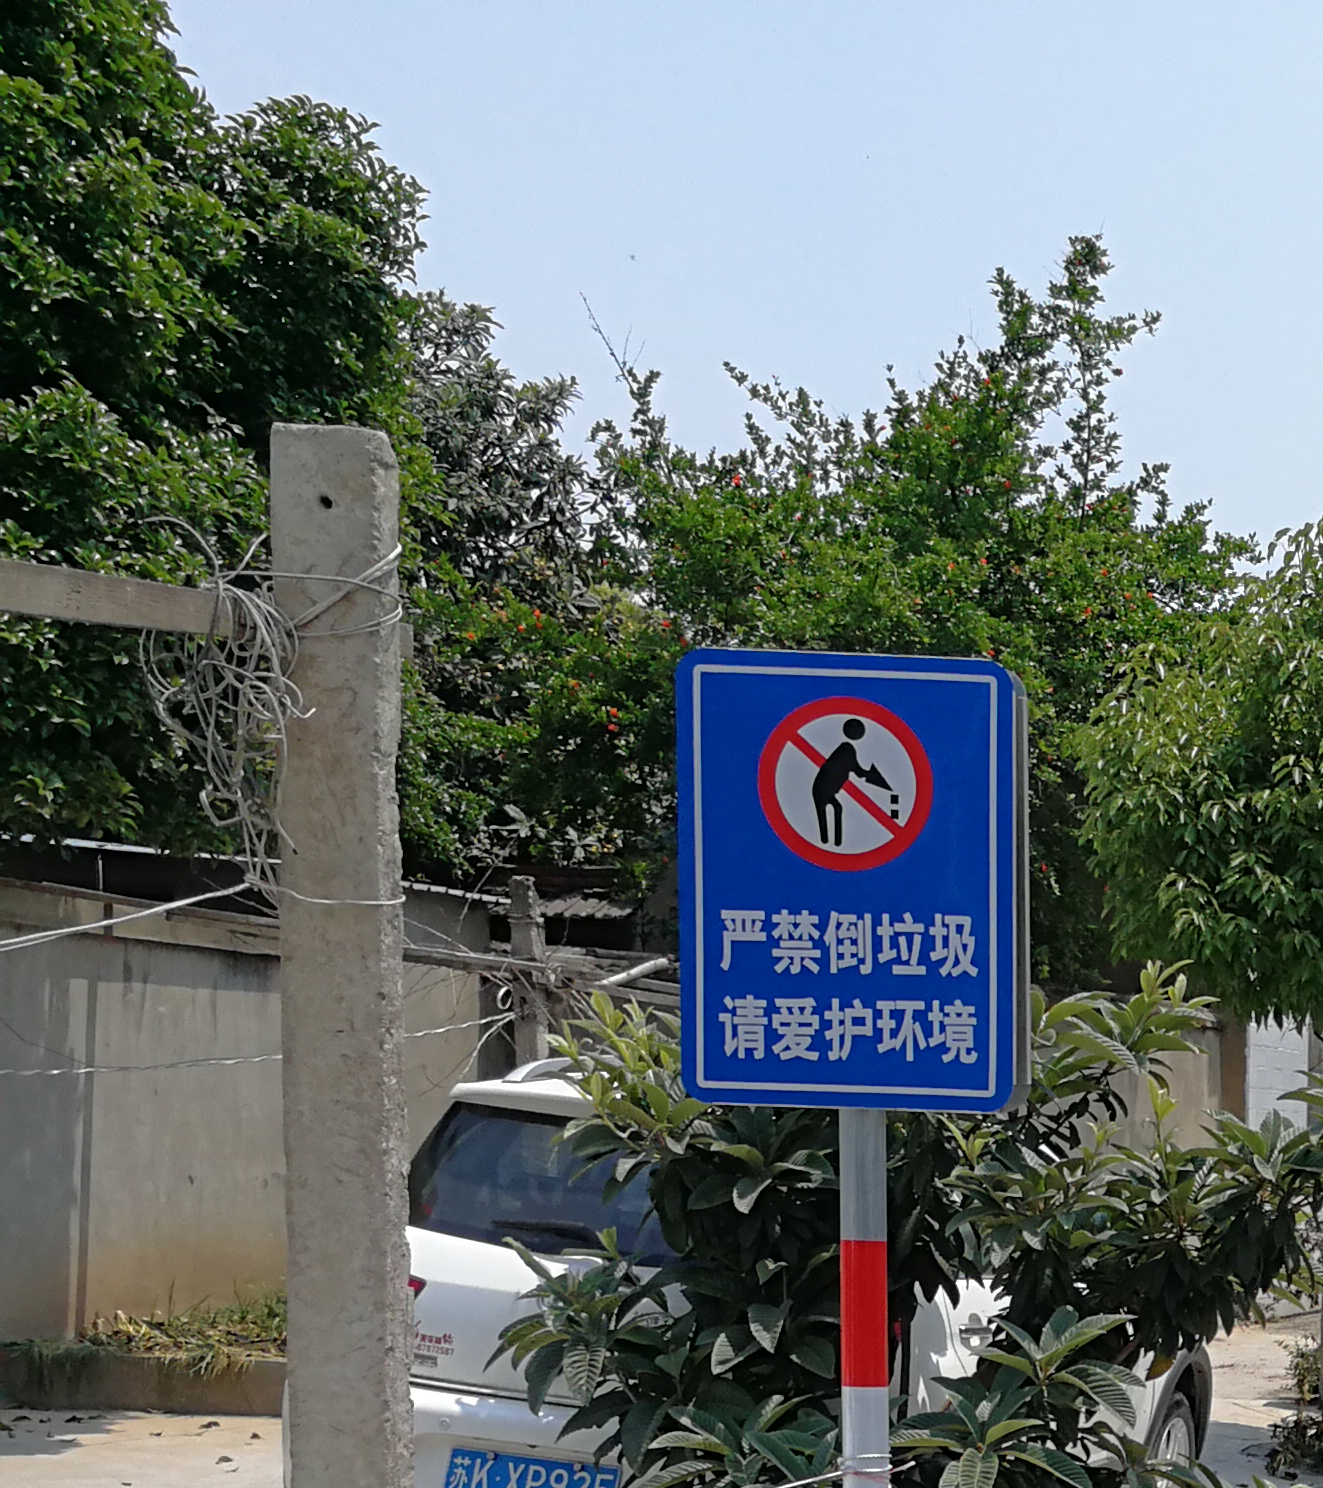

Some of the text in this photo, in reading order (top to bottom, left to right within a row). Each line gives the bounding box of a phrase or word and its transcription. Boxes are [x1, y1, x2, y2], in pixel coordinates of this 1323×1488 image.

[719, 908, 979, 978] 严禁倒垃圾
[718, 994, 979, 1064] 请爱护环境
